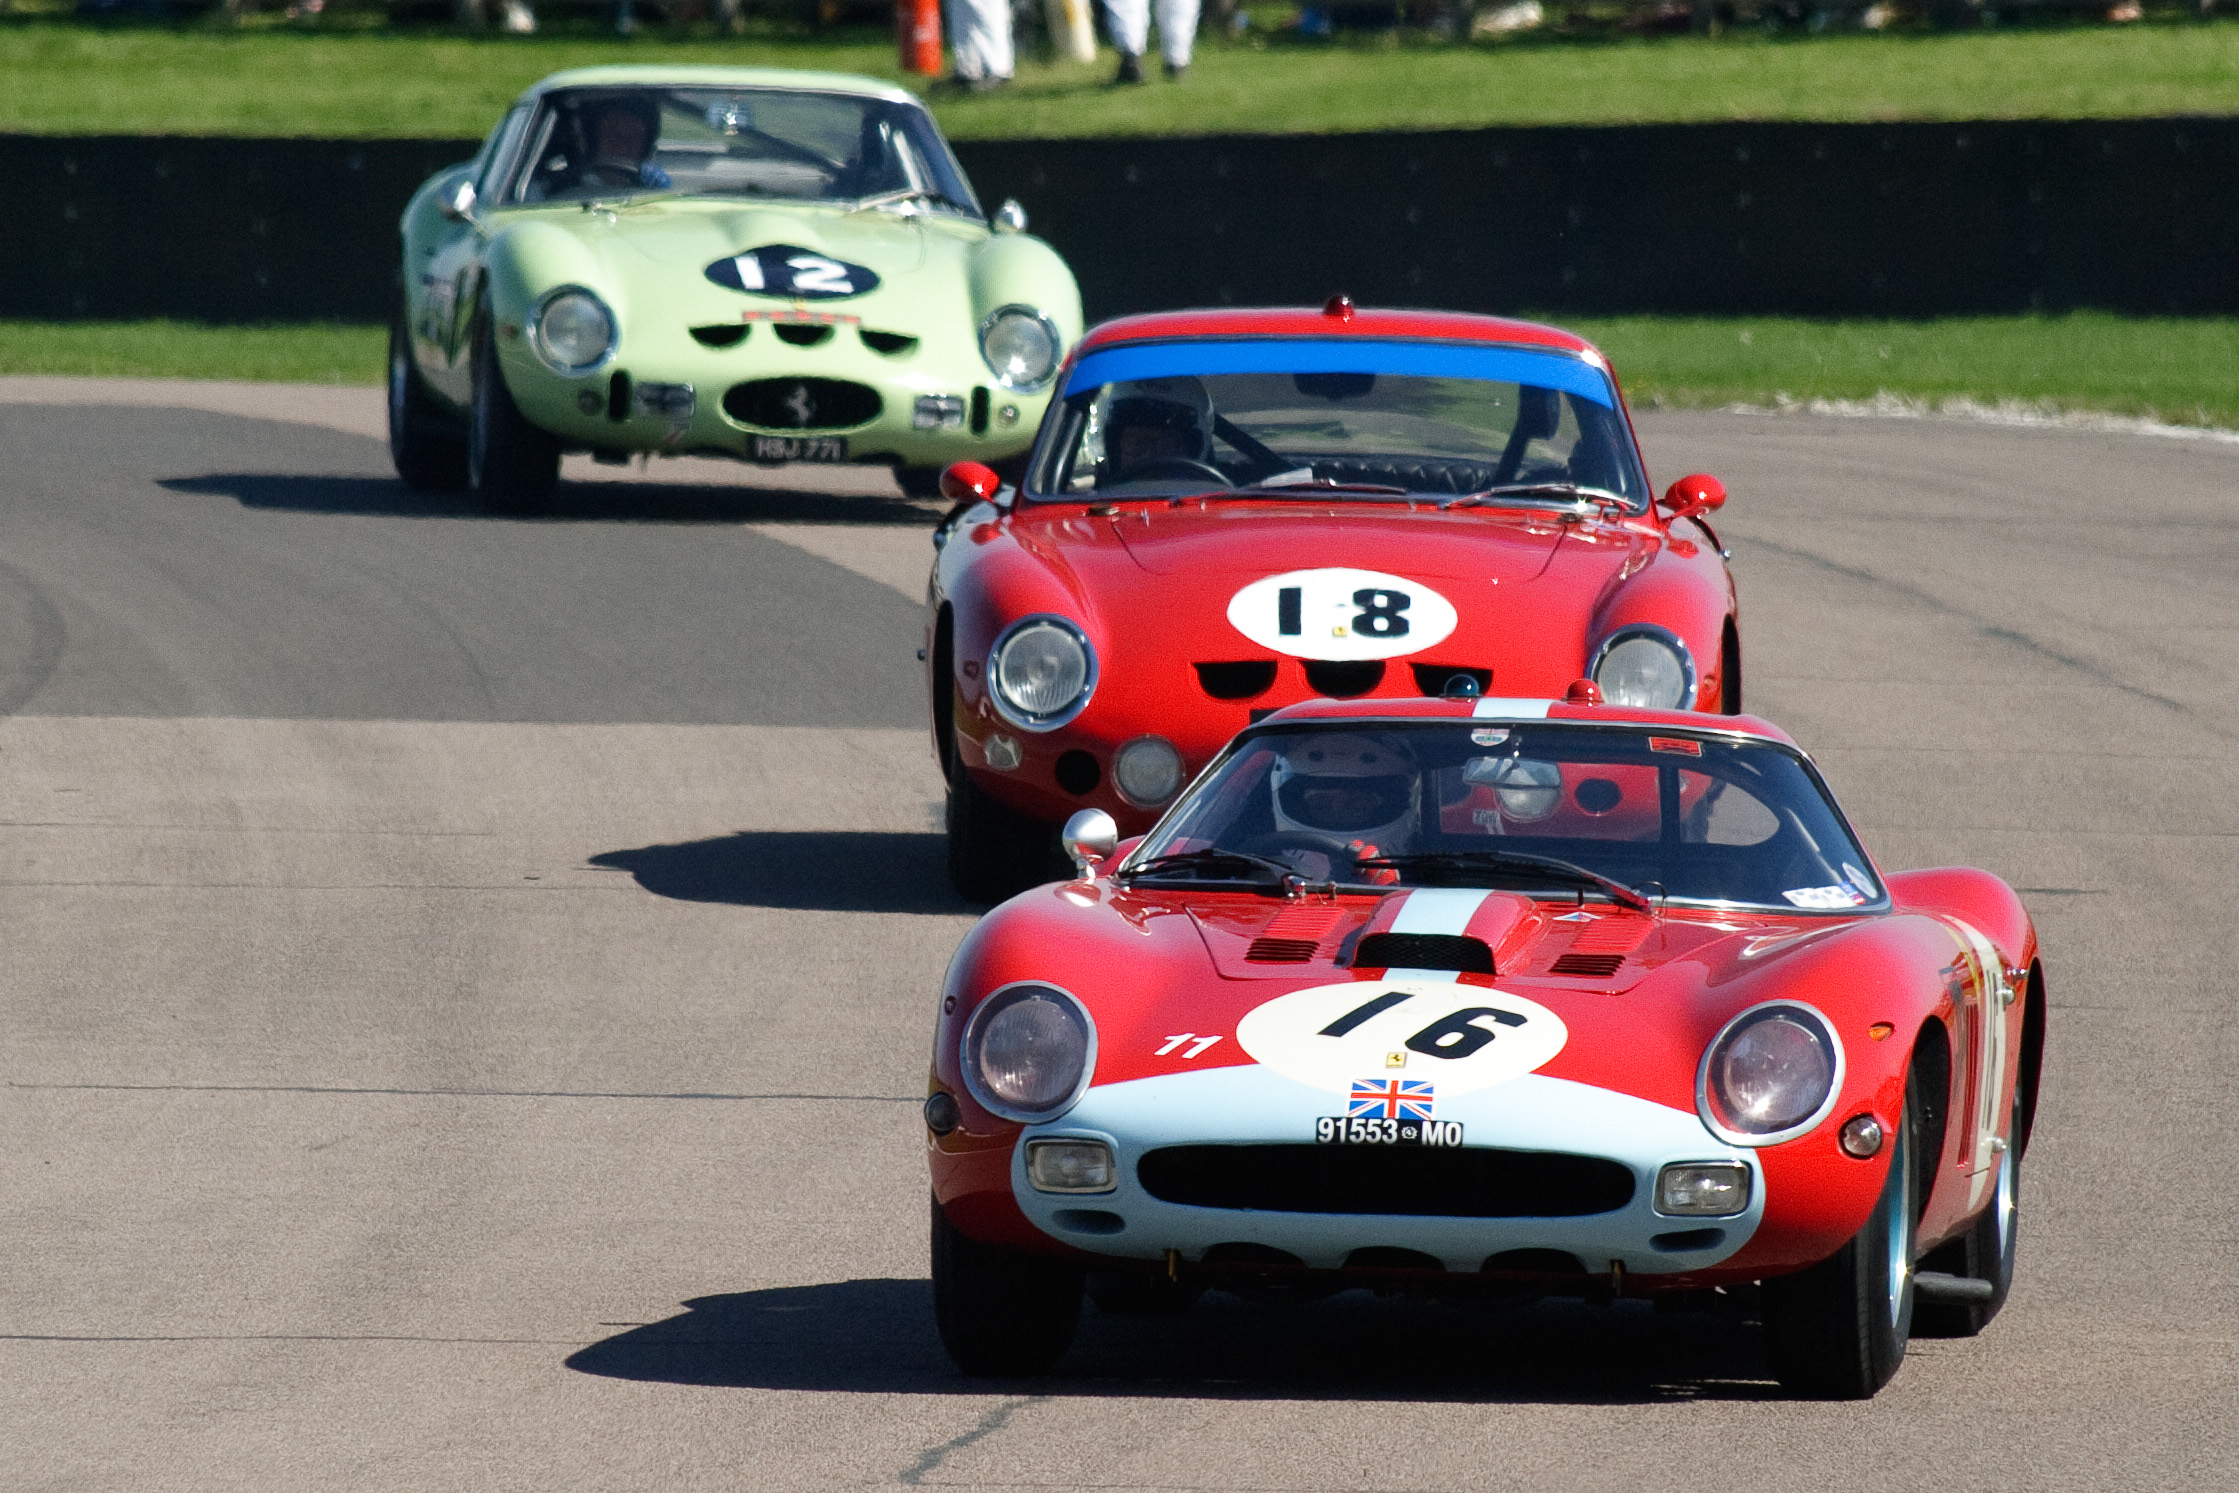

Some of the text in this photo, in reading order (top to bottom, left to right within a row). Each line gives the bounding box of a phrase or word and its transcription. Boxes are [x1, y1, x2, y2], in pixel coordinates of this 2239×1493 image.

[735, 254, 854, 294] 12
[1278, 587, 1411, 638] 18
[1317, 991, 1528, 1059] 16
[1154, 1033, 1223, 1059] 11
[1317, 1117, 1398, 1144] 91553
